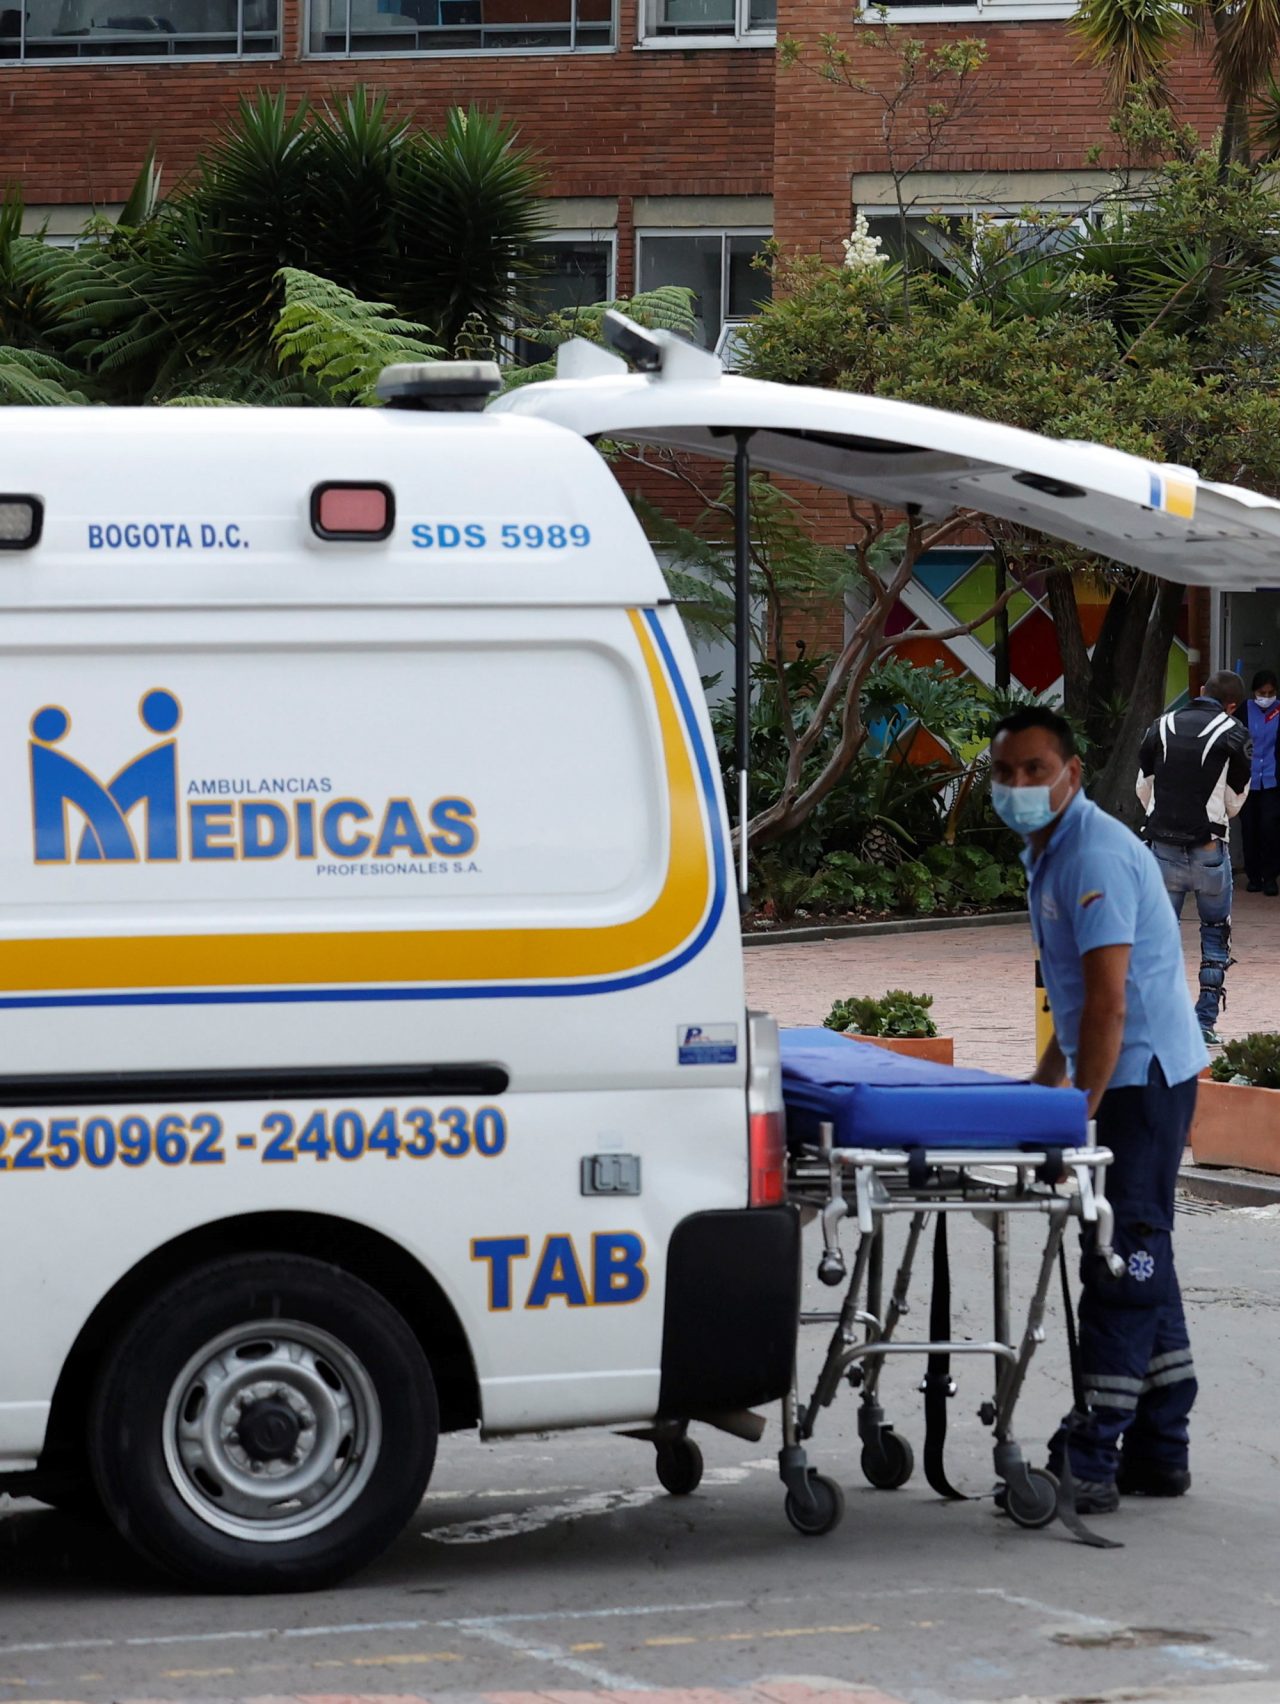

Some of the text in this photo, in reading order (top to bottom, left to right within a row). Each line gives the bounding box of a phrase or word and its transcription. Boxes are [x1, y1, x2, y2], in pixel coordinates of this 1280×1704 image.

[88, 523, 249, 549] BOGOTA D.C.
[411, 523, 591, 549] SDS 5989
[187, 778, 333, 795] AMBULANCIAS
[316, 862, 482, 876] PROFESIONALES S.A.
[469, 1230, 650, 1313] TAB
